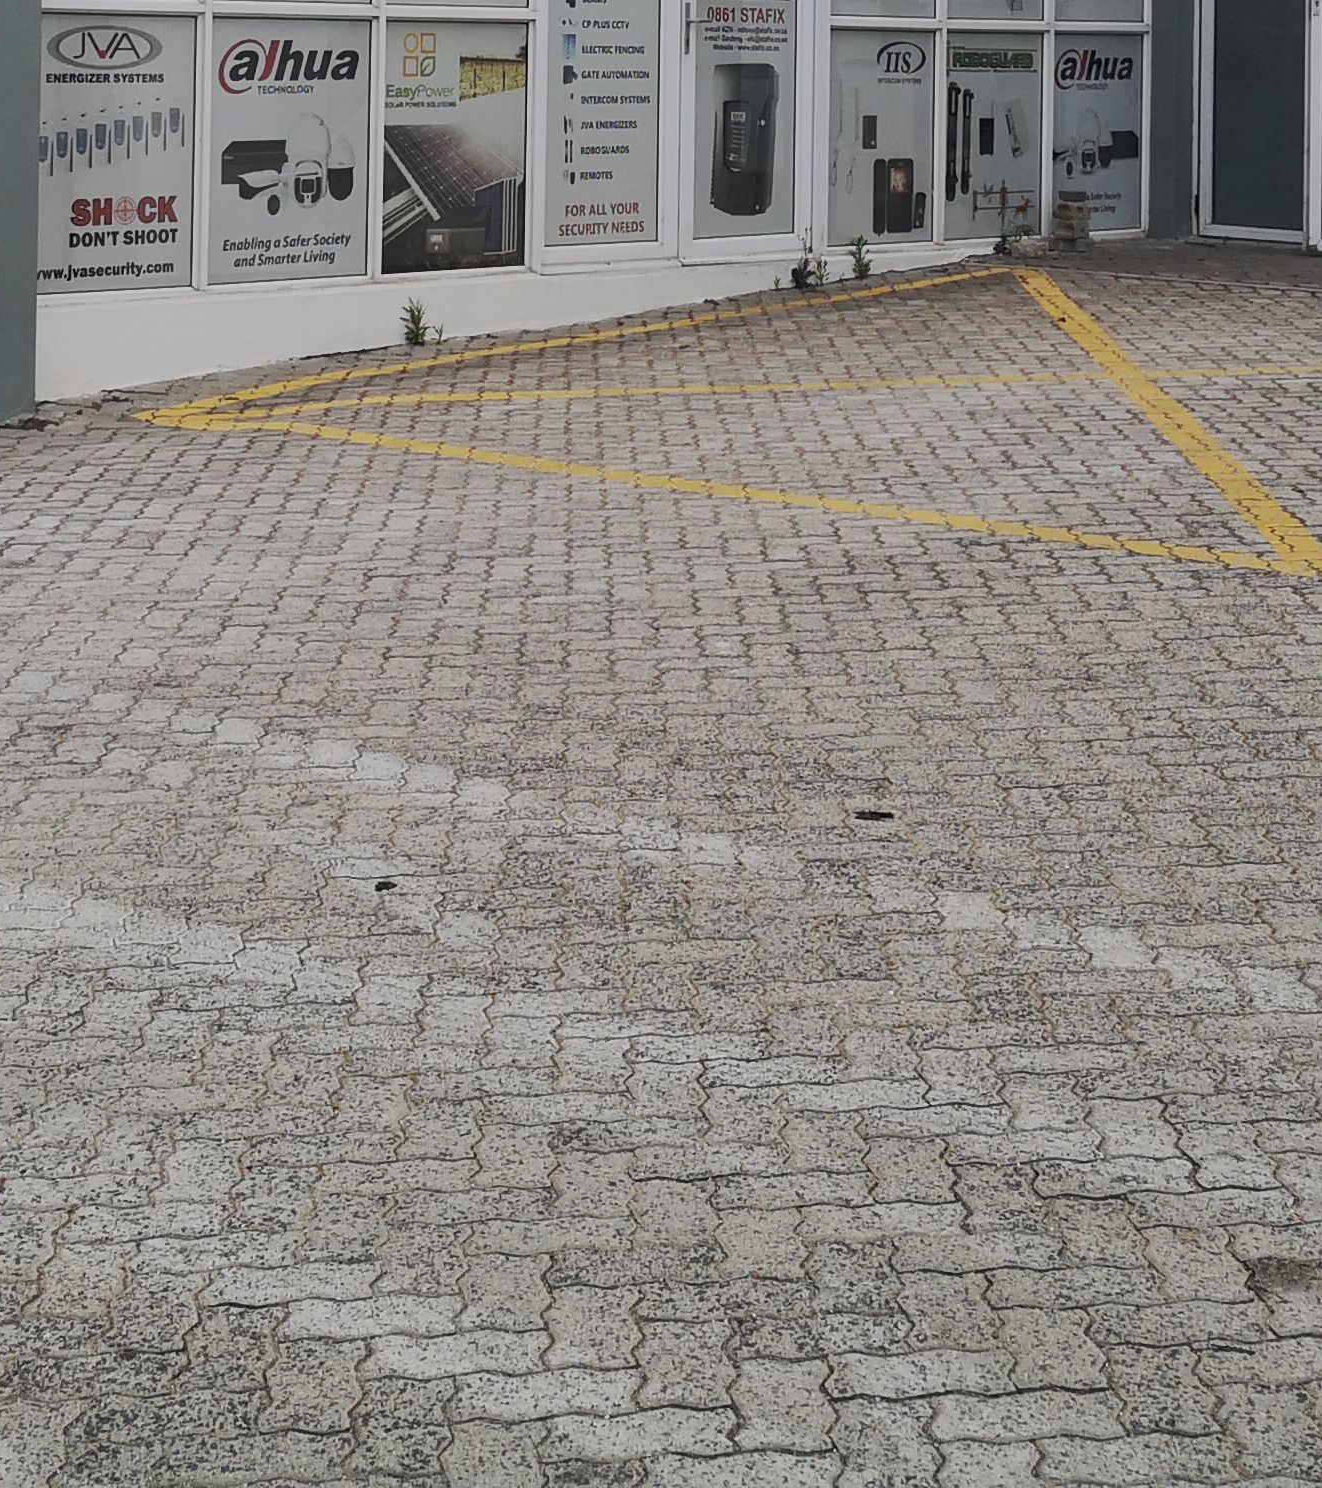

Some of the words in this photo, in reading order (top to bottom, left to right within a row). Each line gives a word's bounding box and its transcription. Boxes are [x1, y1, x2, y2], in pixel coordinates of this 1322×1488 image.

[707, 7, 736, 23] 0861
[740, 7, 786, 24] STAFIX
[73, 32, 141, 60] JVA
[582, 45, 613, 54] ELECTRIC
[615, 45, 645, 54] FENCING
[45, 73, 111, 84] ENERGIZER
[113, 73, 165, 84] SYSTEMS
[581, 70, 600, 79] GATE
[601, 70, 650, 79] AUTOMATION
[257, 85, 315, 95] TECHNOLOGY
[385, 84, 455, 101] EasyPower
[581, 95, 618, 105] INTERCOM
[619, 95, 651, 104] SYSTEMS
[565, 204, 586, 218] FOR
[588, 203, 607, 216] ALL
[610, 202, 640, 215] YOUR
[558, 222, 609, 237] SECURITY
[611, 220, 645, 234] NEEDS
[68, 231, 120, 249] DON'T
[122, 228, 179, 246] SHOOT
[222, 236, 272, 253] Enabling
[273, 240, 281, 248] a
[282, 234, 312, 248] Safer
[313, 232, 352, 247] Society
[233, 254, 256, 268] and
[257, 251, 302, 266] Smarter
[303, 250, 336, 265] Living
